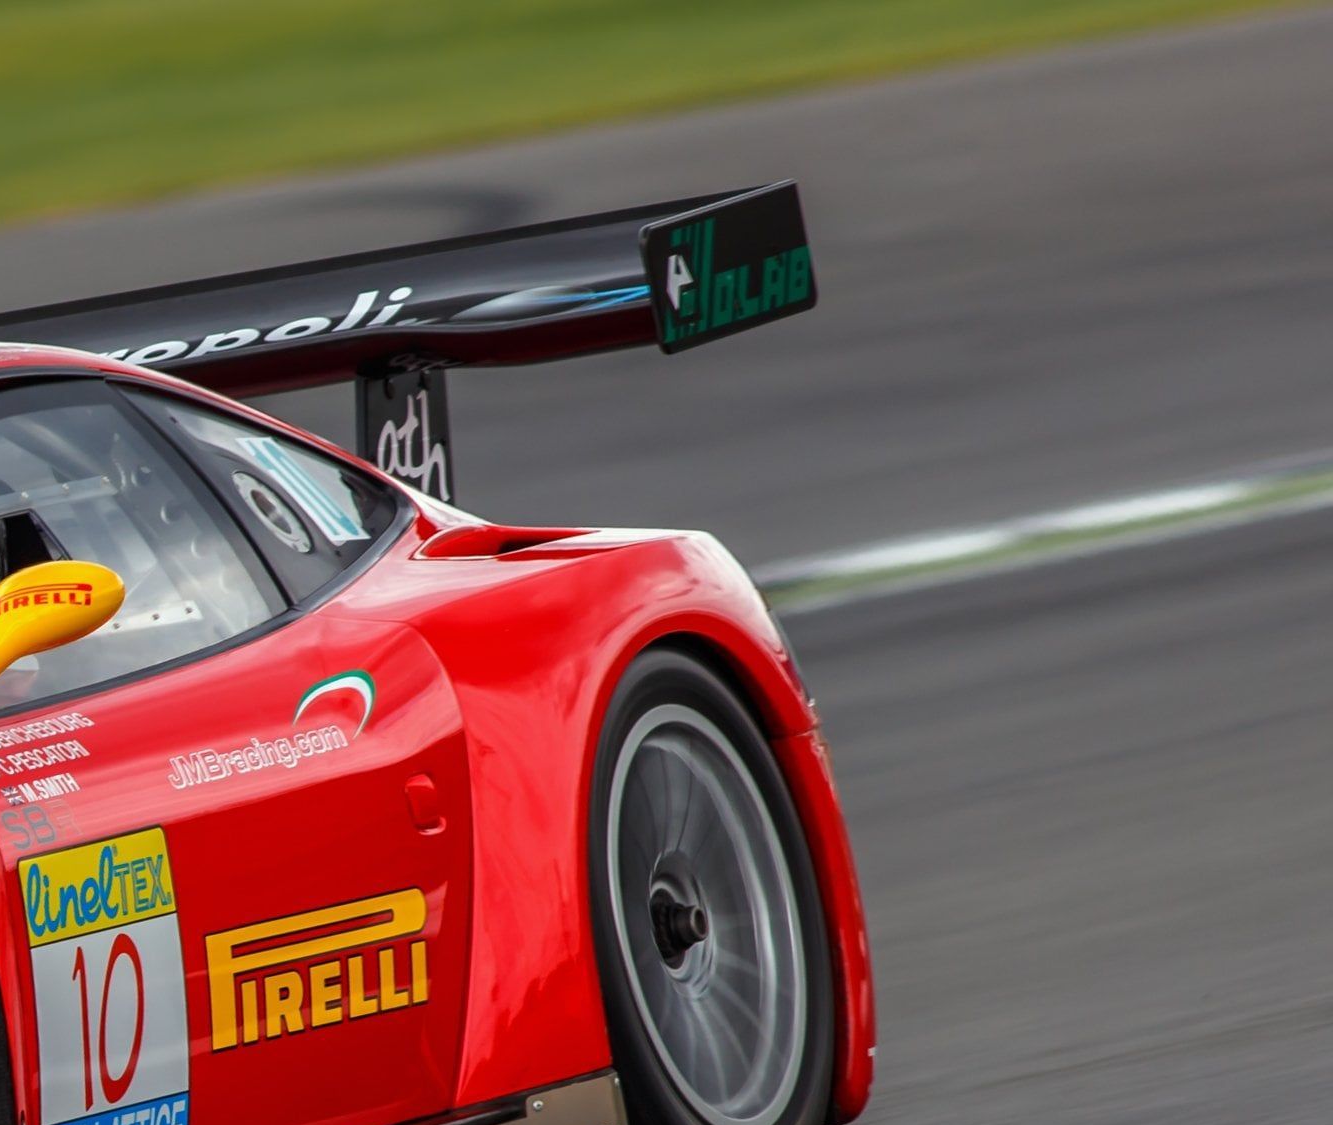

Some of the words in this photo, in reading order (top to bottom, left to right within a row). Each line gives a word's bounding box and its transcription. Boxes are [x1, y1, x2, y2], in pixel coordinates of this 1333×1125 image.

[18, 773, 81, 803] M.SMITH
[167, 724, 349, 789] JMBracing.com
[72, 933, 145, 1112] 10
[206, 887, 429, 1052] PIRELLI
